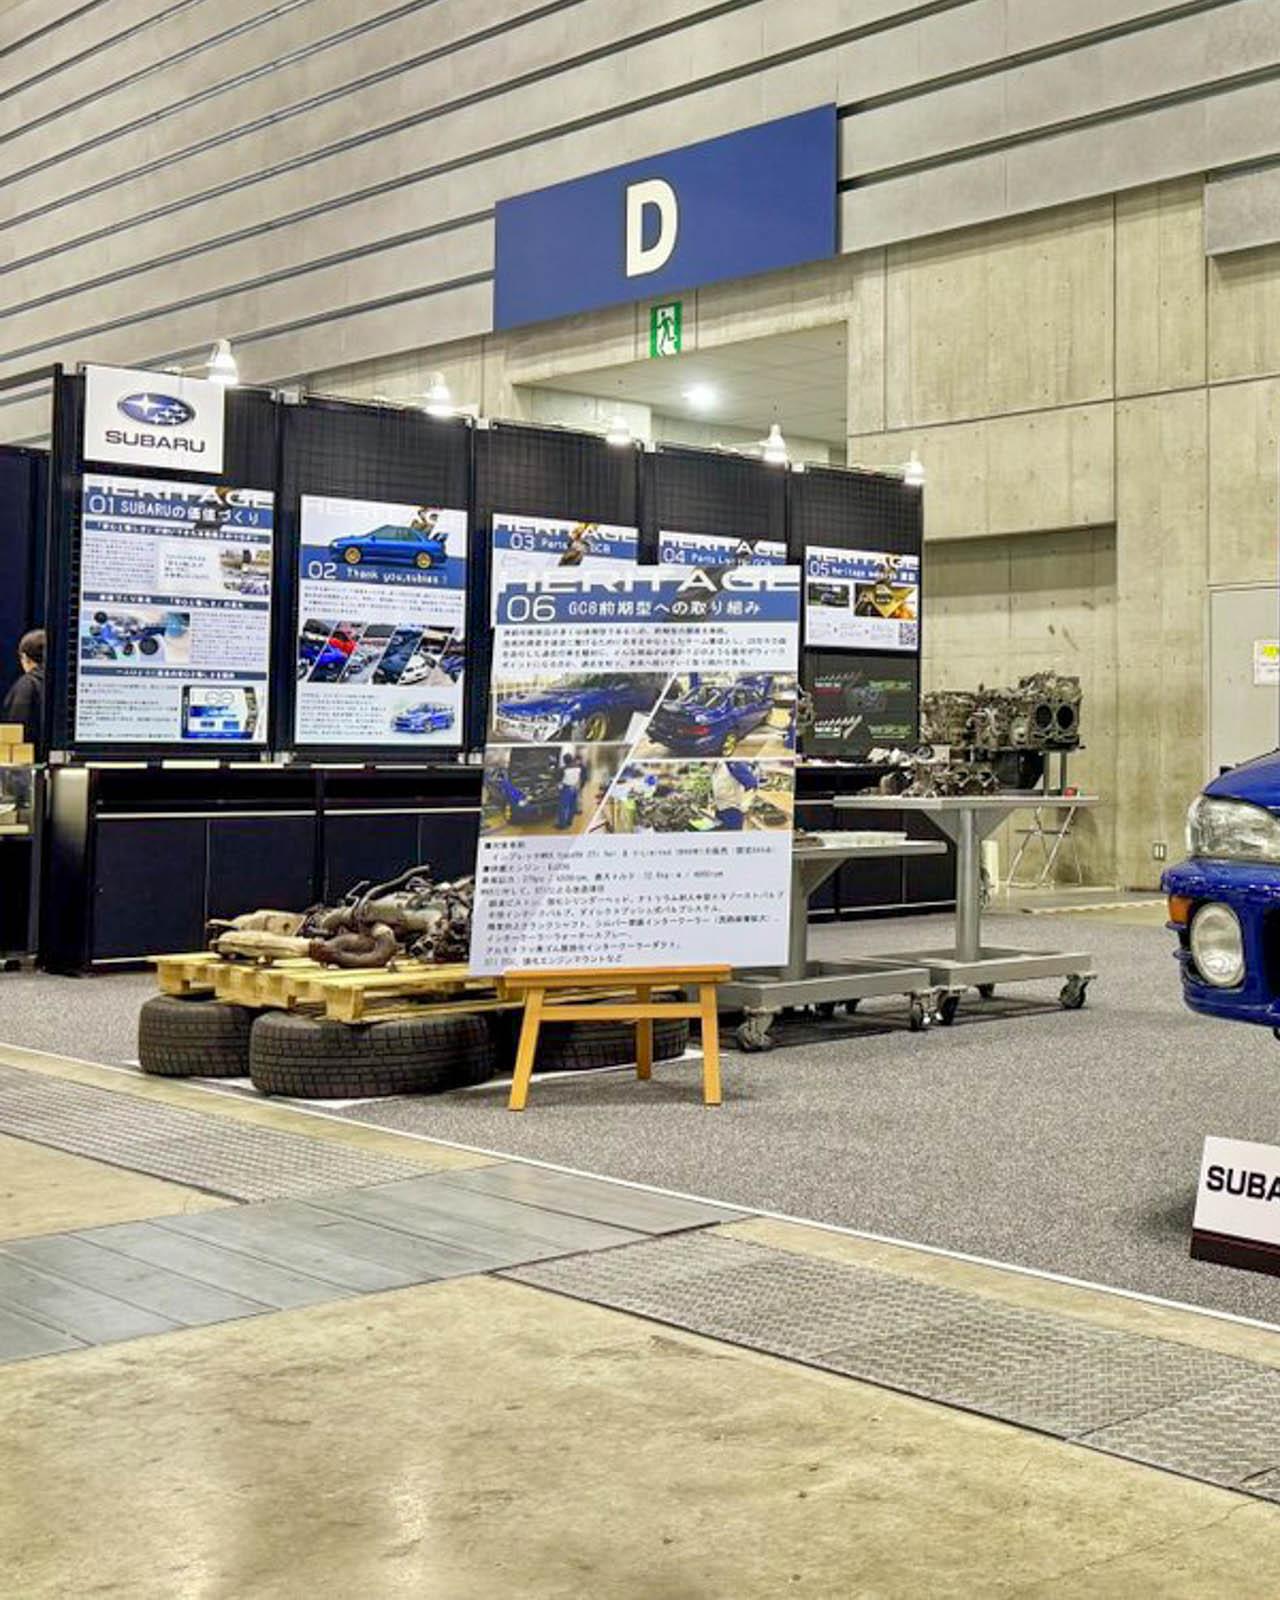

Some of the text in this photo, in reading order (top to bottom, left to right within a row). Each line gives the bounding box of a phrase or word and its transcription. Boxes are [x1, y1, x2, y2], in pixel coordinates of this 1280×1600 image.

[627, 178, 678, 278] D
[105, 430, 206, 454] SUBARU
[89, 495, 260, 525] 01 SUBARUの価値づくり
[510, 533, 534, 551] 03
[663, 547, 685, 563] 04
[308, 560, 338, 580] 02
[500, 568, 800, 593] HERITAGE
[810, 560, 830, 577] 05
[507, 595, 761, 622] 06 GC8前期型への取り組み
